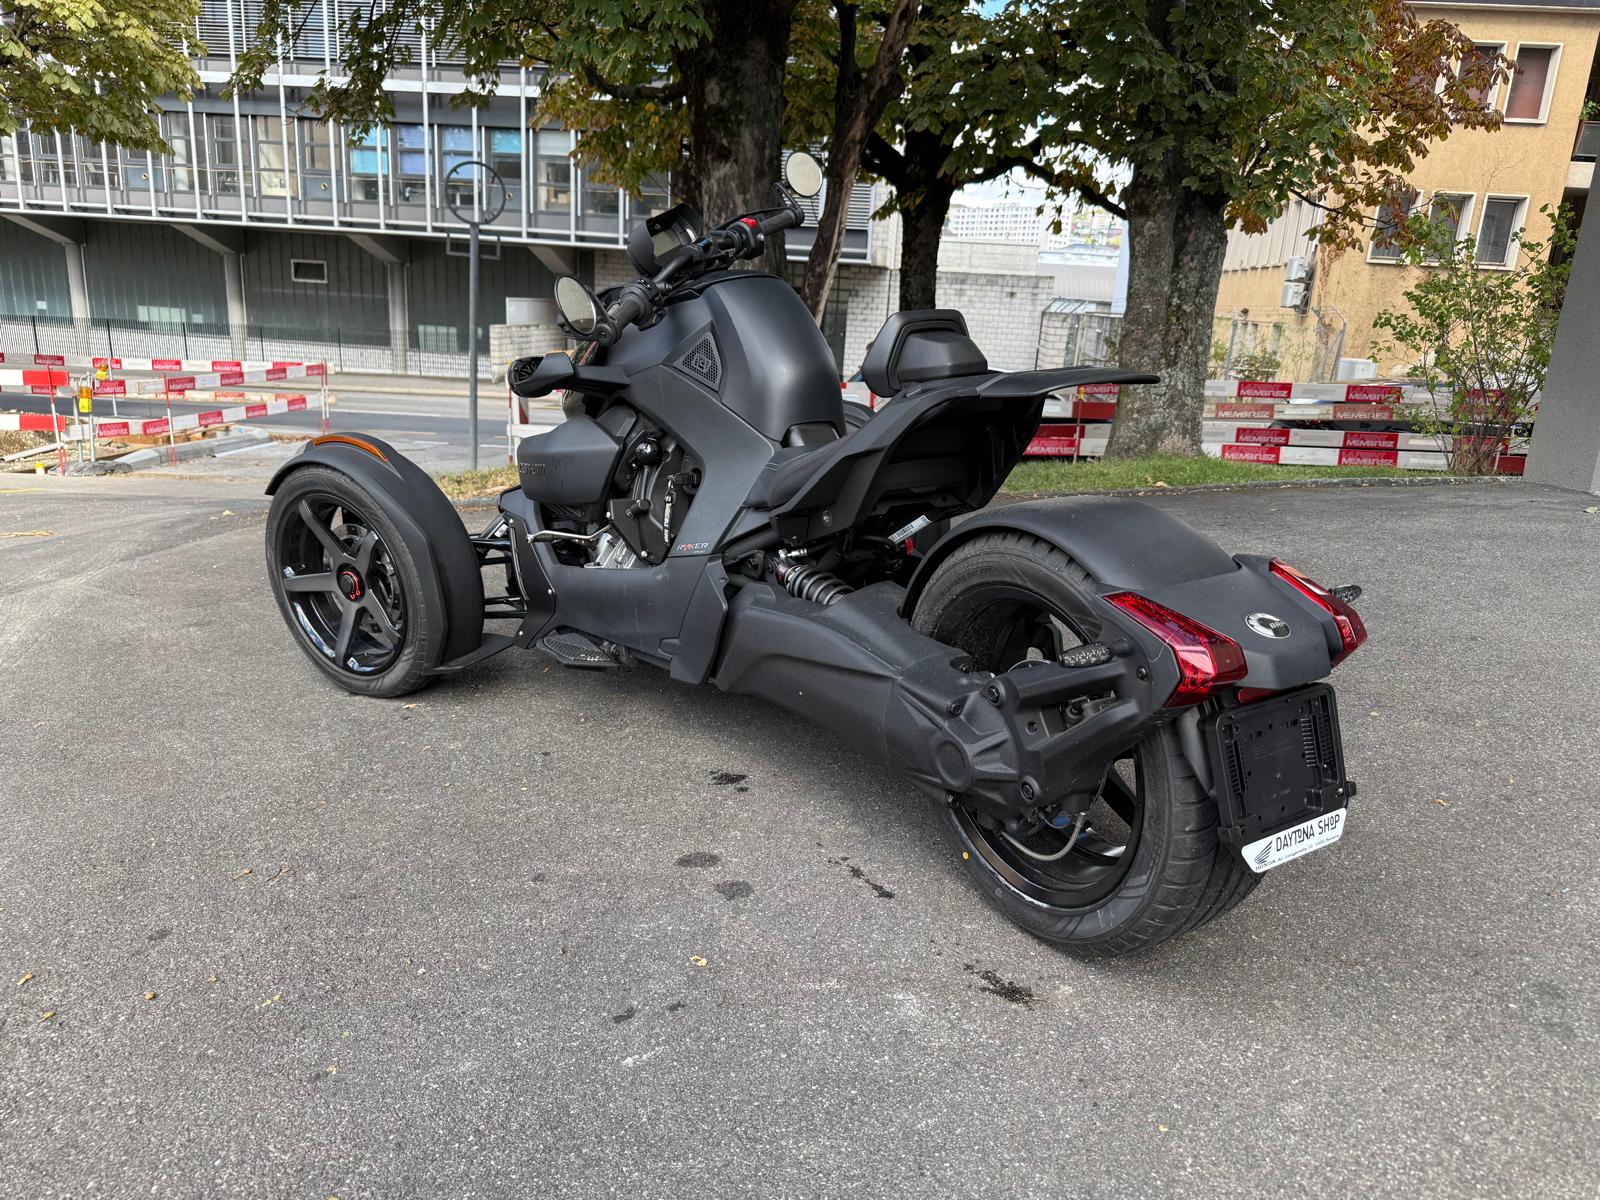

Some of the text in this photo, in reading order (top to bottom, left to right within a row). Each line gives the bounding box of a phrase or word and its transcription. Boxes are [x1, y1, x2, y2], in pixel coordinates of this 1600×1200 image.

[1240, 389, 1288, 397] MEMBREZ
[1218, 410, 1270, 418] MEMBREZ
[1239, 435, 1287, 443] MEMBREZ
[1224, 452, 1276, 461] MEMBREZ
[1341, 457, 1394, 465] MEMBREZ
[1276, 814, 1340, 852] DAYTONA SHOP
